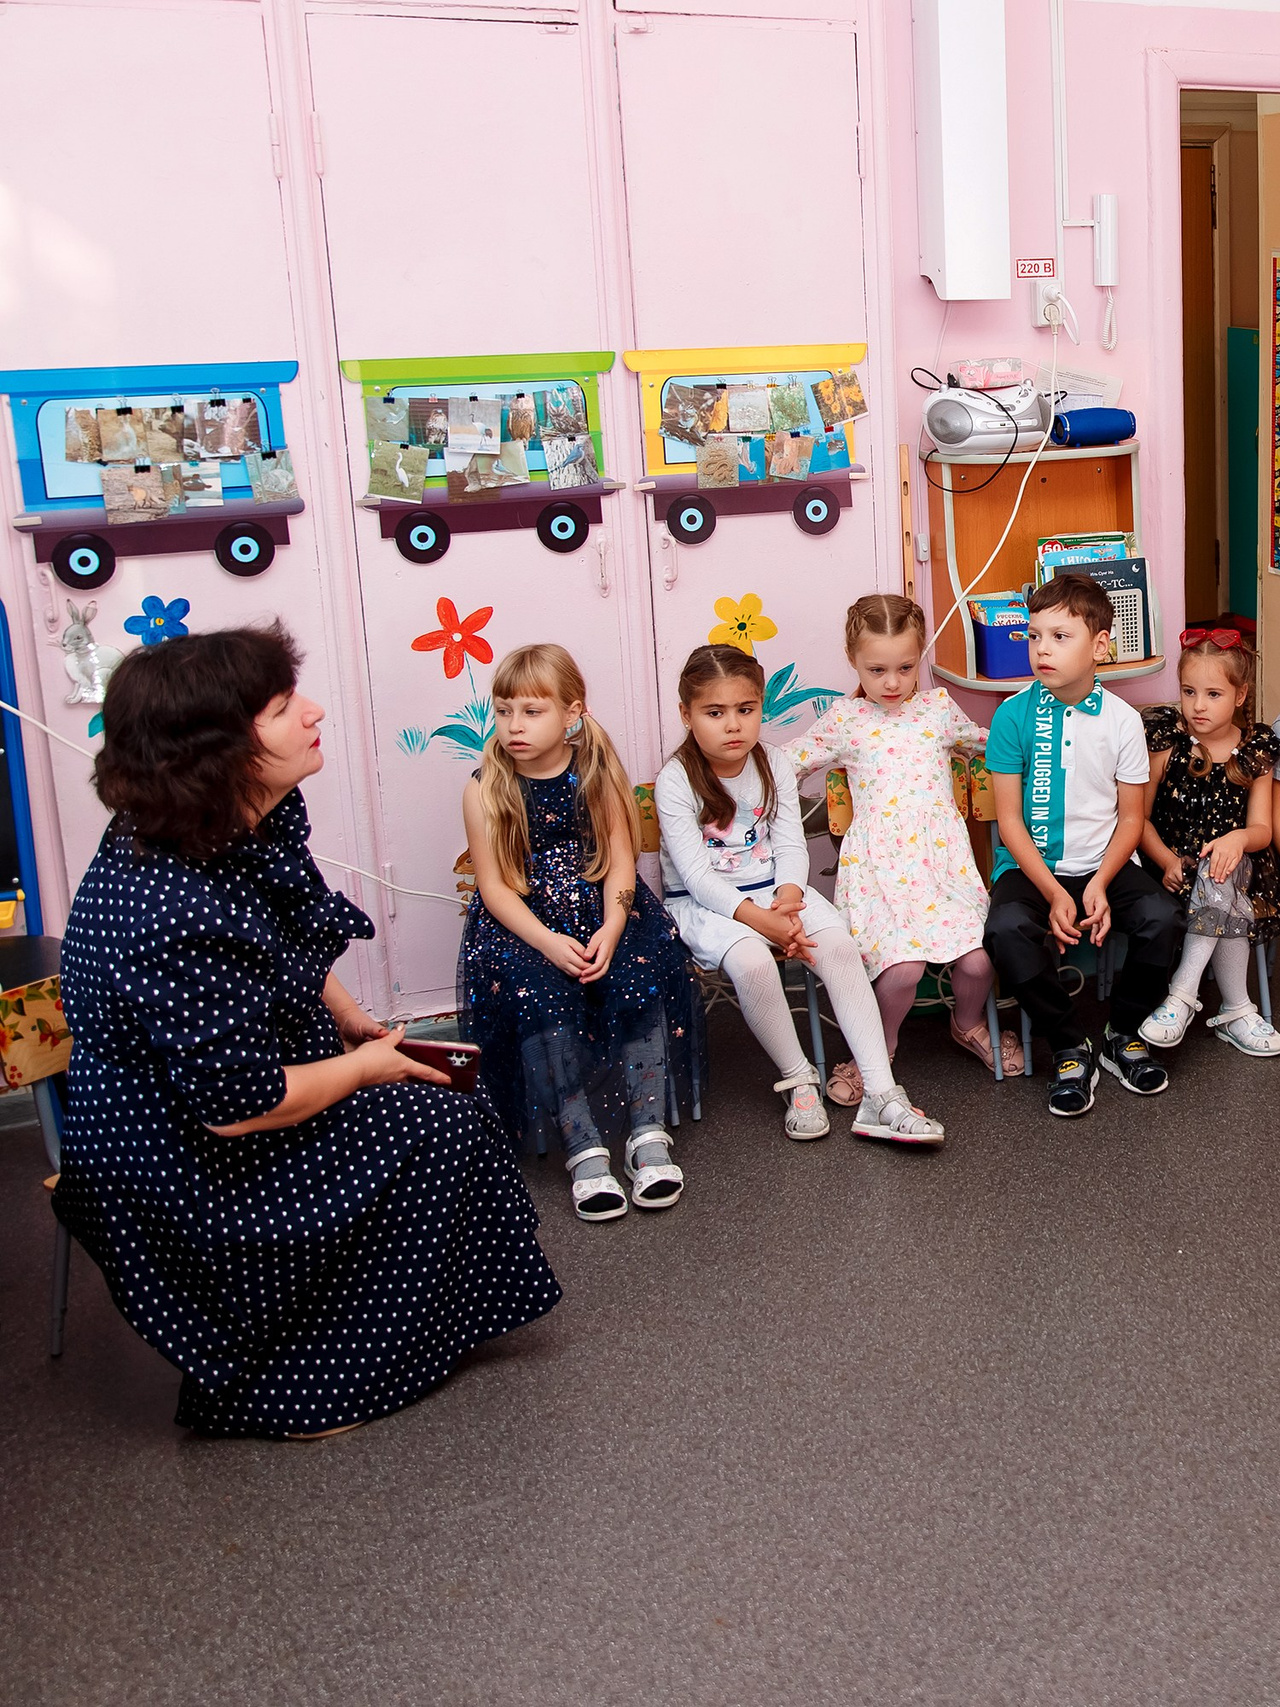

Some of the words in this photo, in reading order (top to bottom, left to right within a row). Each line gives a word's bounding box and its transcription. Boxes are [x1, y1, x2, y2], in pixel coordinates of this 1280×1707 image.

[1020, 263, 1040, 274] 220
[1043, 262, 1052, 273] В
[1044, 543, 1061, 553] 50
[1035, 706, 1053, 740] STAY
[1032, 742, 1052, 803] PLUGGED
[1031, 806, 1050, 820] IN
